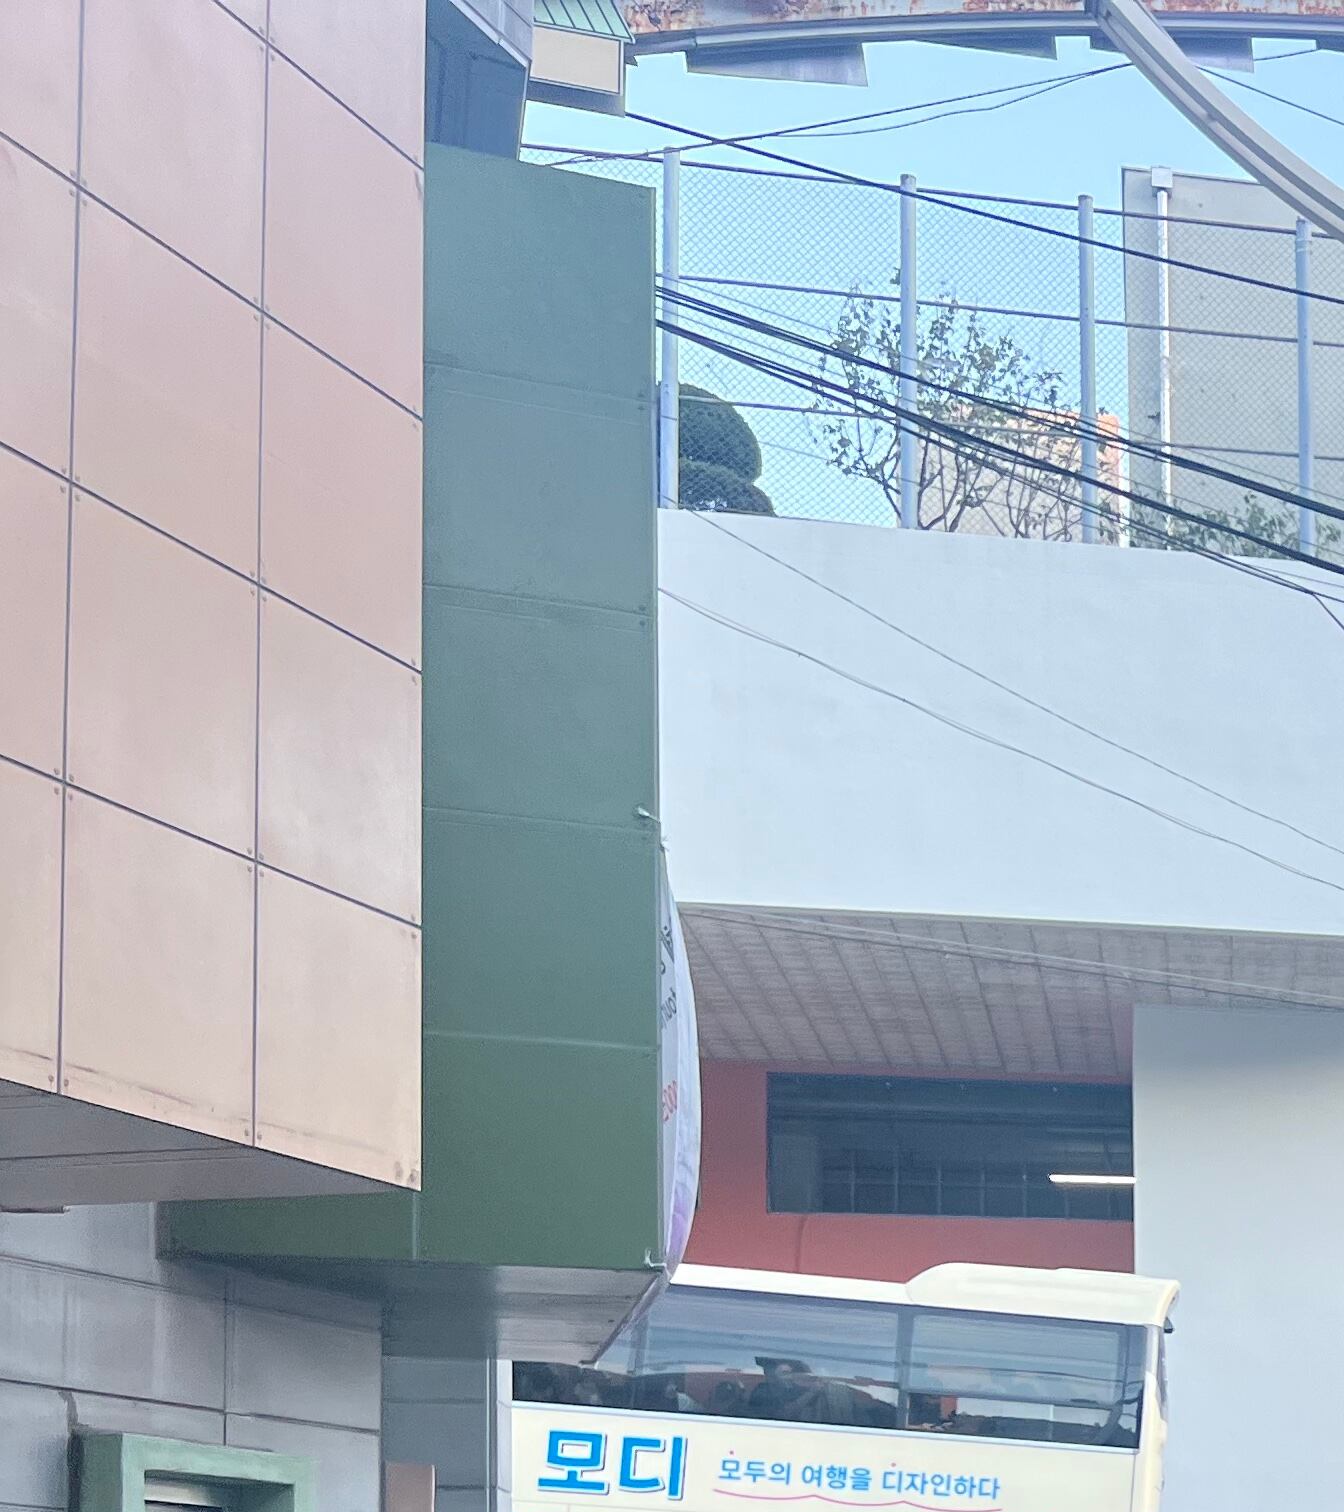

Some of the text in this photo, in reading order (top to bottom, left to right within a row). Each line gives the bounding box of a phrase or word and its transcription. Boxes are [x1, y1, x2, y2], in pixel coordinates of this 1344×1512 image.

[537, 1428, 688, 1501] 모디
[717, 1456, 1001, 1501] 모두의 여행을 디자인하다
